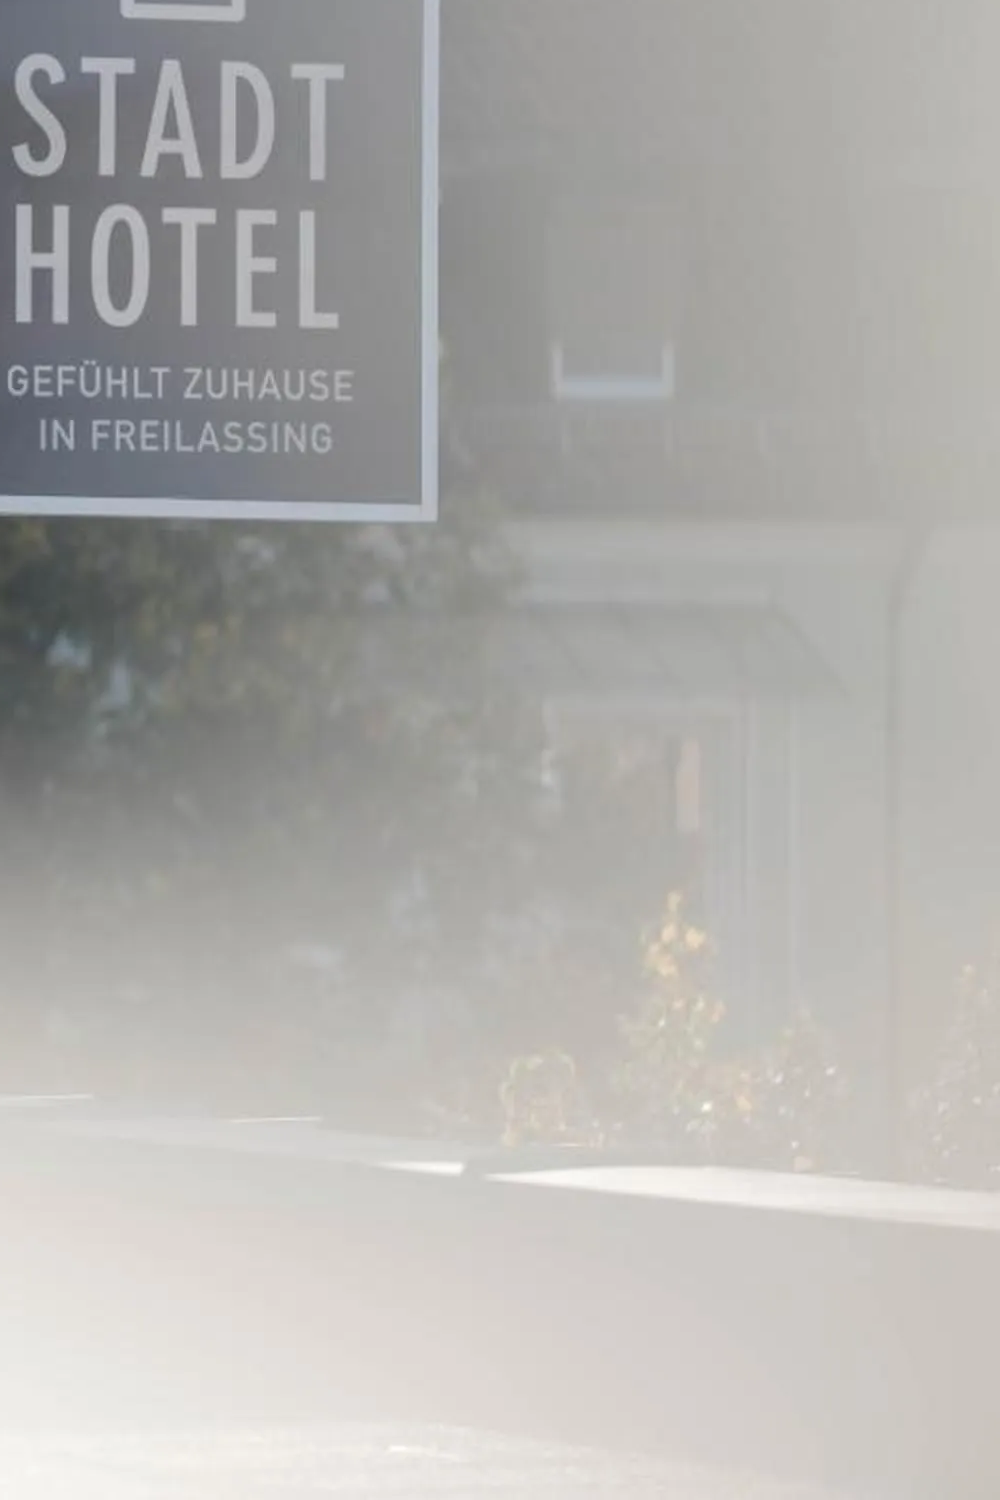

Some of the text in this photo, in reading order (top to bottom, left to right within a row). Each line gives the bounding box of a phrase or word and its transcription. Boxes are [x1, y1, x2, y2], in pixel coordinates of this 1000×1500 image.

[11, 52, 345, 181] STADT
[14, 203, 339, 329] HOTEL
[6, 359, 354, 401] GEFÜHLT ZUHAUSE
[39, 419, 333, 453] IN FREILASSING
